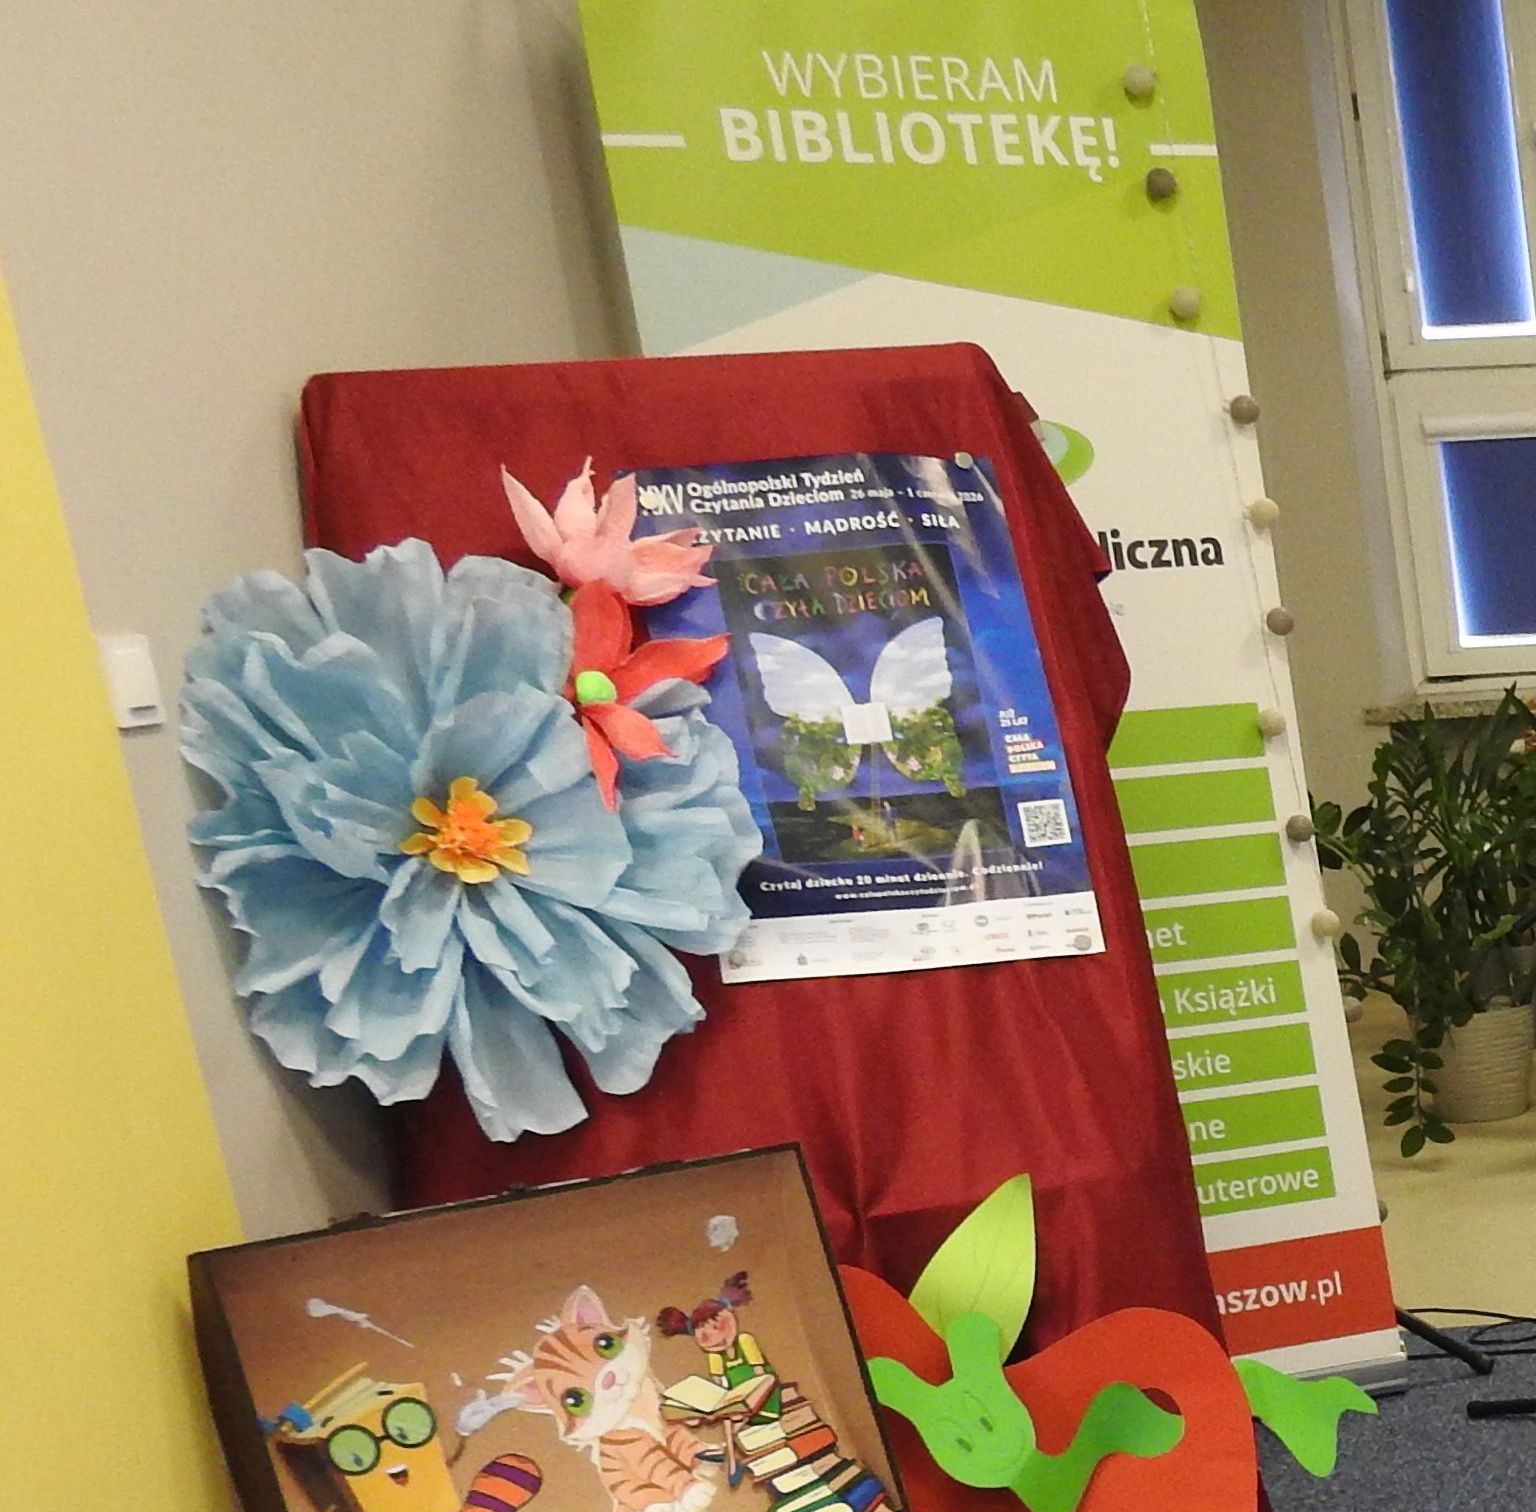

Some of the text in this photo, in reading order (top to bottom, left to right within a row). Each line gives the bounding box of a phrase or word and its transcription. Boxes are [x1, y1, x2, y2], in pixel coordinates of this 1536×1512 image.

[762, 51, 1058, 103] WYBIERAM
[719, 107, 1120, 183] BIBLIOTEKĘ!
[686, 474, 798, 498] Ogólnopolski
[800, 468, 865, 488] Tydzień
[690, 495, 765, 514] Czytania
[767, 489, 845, 506] Dzieciom
[698, 511, 960, 544] ZYTANIE MĄDROŚĆ SIŁA
[824, 561, 923, 587] POLSKA
[831, 587, 931, 615] DZIECIOM
[1174, 977, 1277, 1015] Książki
[1172, 1049, 1231, 1080] skie
[1189, 1118, 1226, 1142] ne
[1197, 1168, 1320, 1205] uterowe
